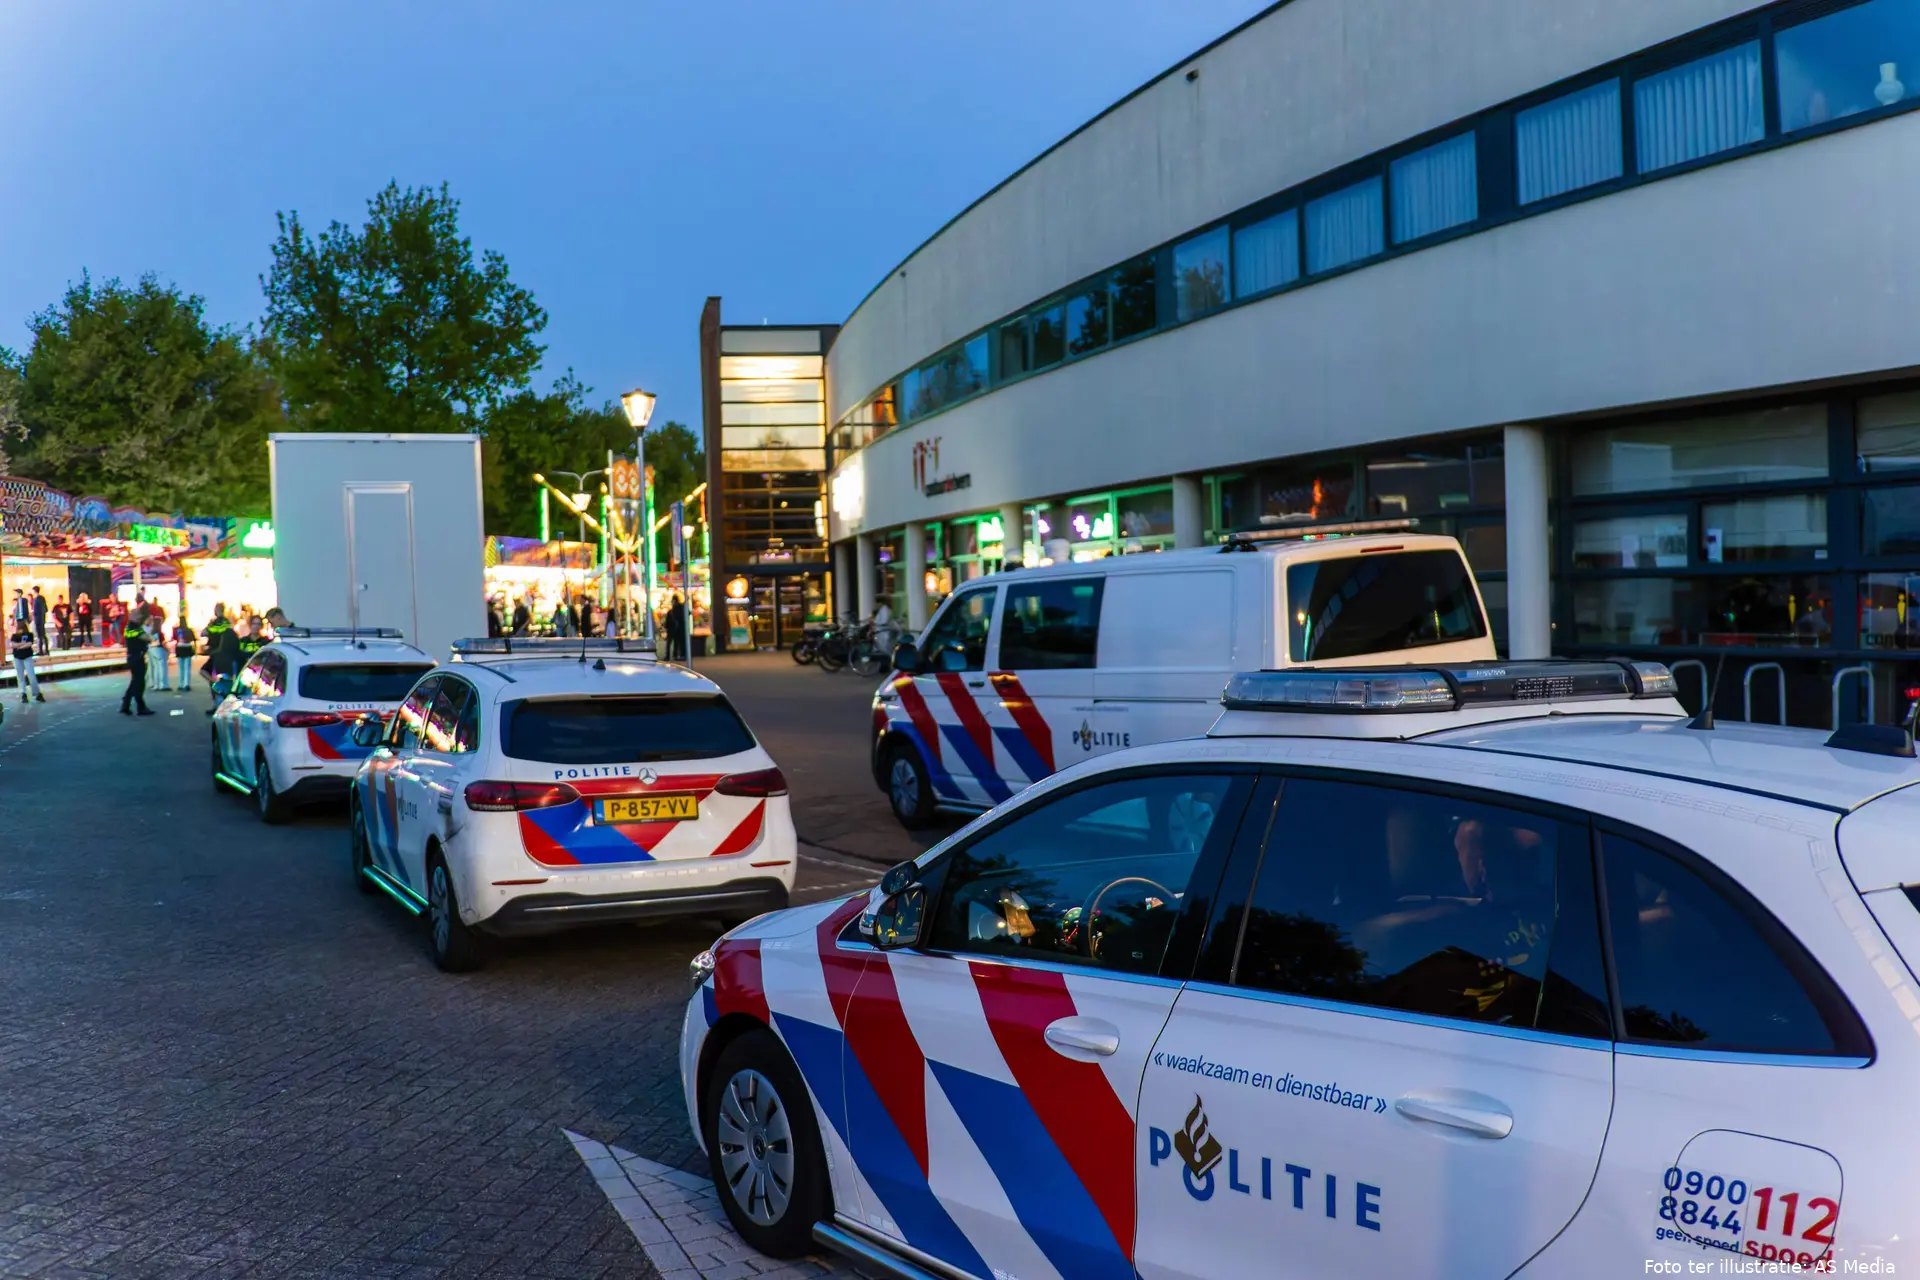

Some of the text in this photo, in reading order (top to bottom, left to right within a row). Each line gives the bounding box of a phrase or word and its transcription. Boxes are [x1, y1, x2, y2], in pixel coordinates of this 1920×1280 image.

[1072, 730, 1130, 751] POLITIE
[554, 765, 632, 779] POLITIE
[610, 798, 689, 818] P-857-VV
[1166, 1054, 1249, 1085] waakzaam
[1251, 1071, 1273, 1090] en
[1275, 1072, 1373, 1111] dienstbaar
[1149, 1126, 1381, 1232] POLITIE
[1663, 1166, 1748, 1206] 0900
[1659, 1196, 1742, 1235] 8844
[1753, 1186, 1838, 1245] 112
